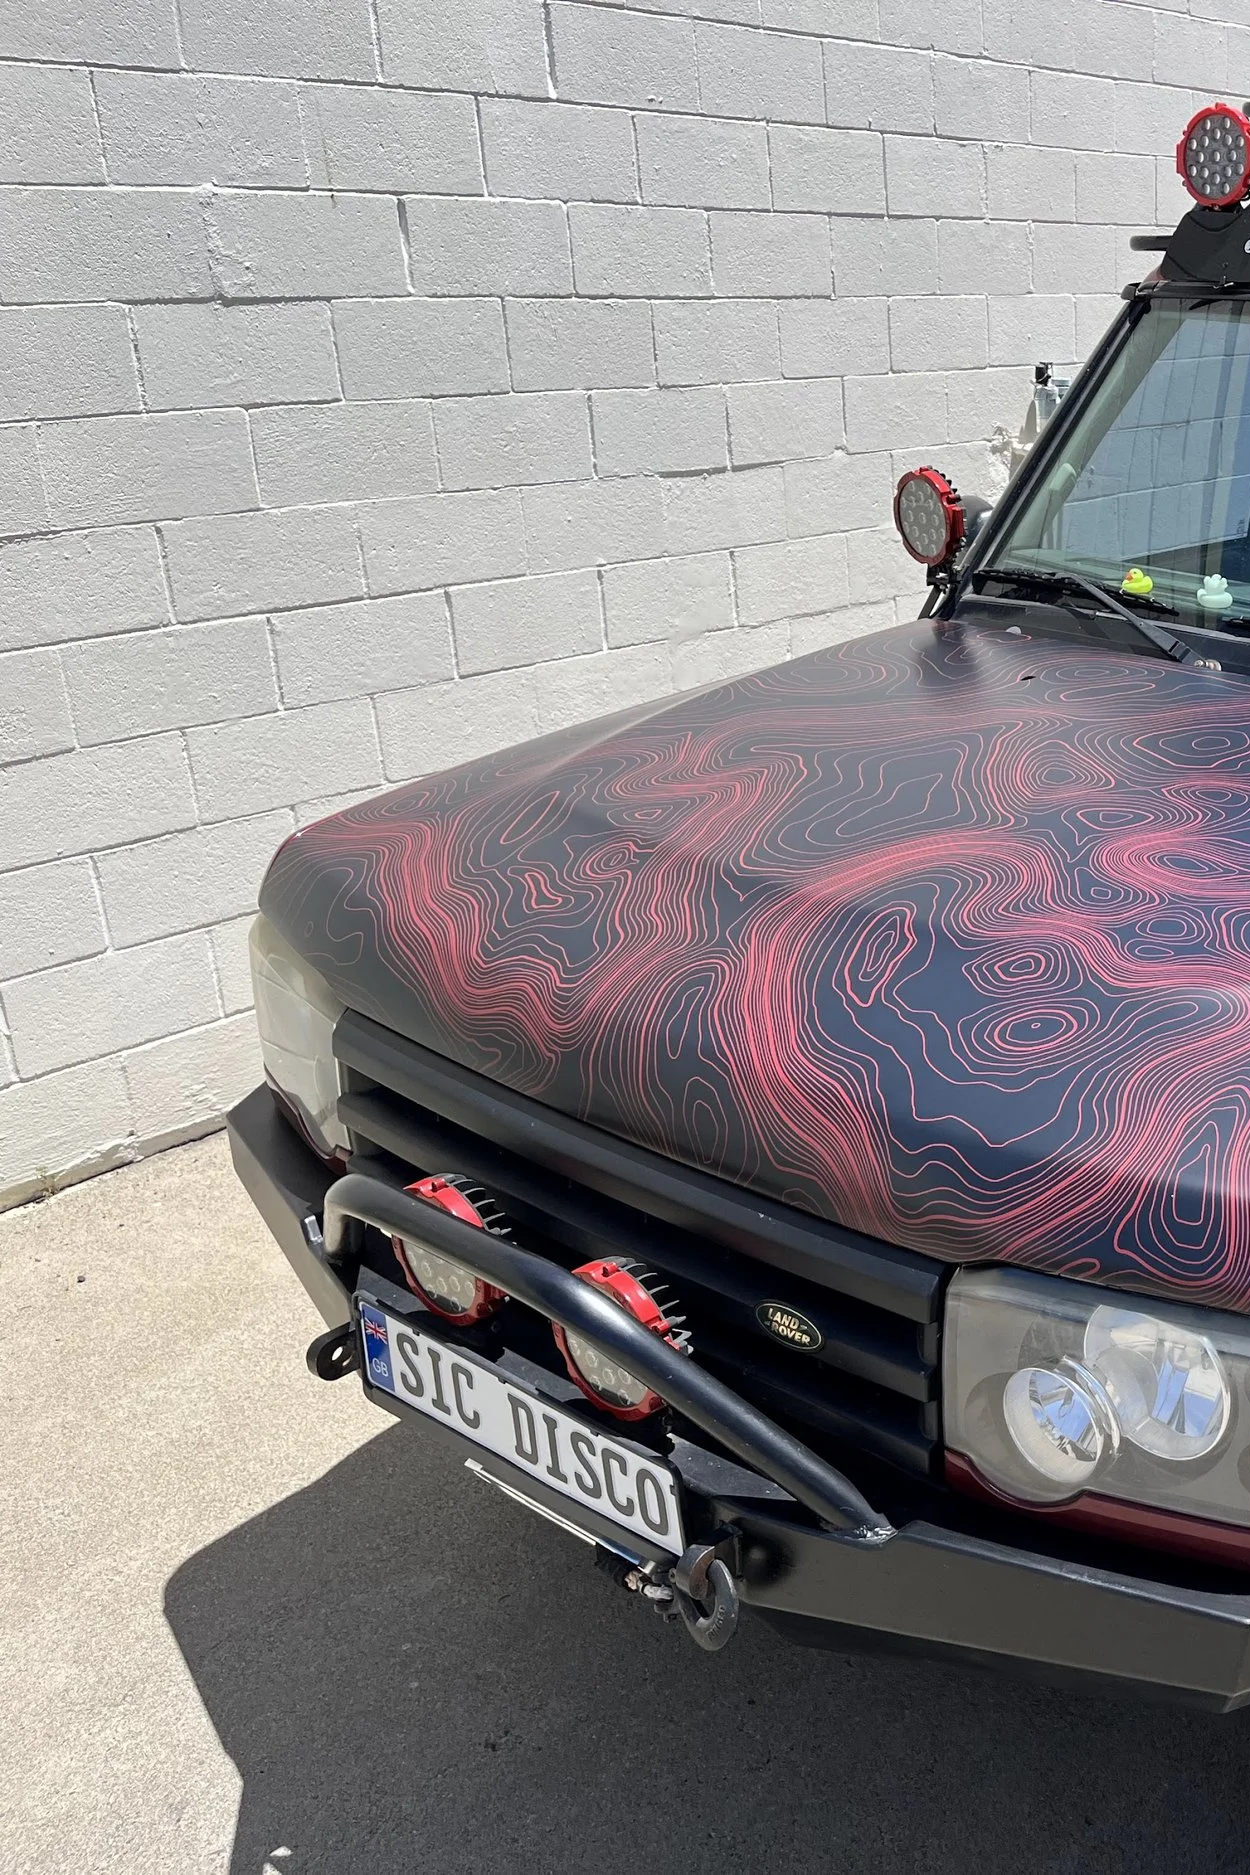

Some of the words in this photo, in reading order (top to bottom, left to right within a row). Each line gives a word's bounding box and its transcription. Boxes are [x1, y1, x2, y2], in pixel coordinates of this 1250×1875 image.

[768, 1308, 800, 1330] LAND
[771, 1321, 811, 1346] ROVER
[371, 1357, 389, 1377] GB
[396, 1332, 480, 1429] SIC
[507, 1392, 669, 1536] DISCO
